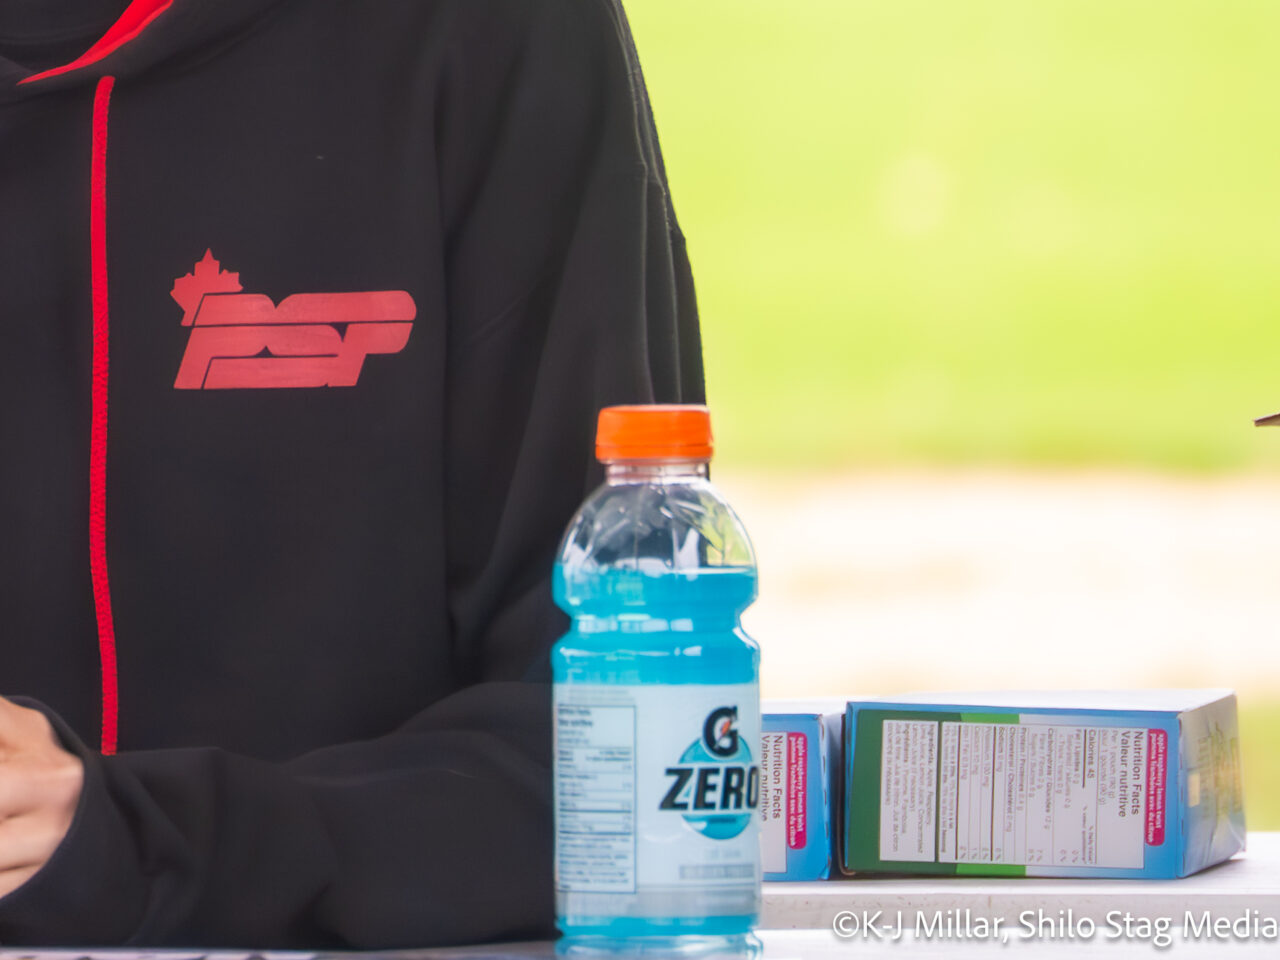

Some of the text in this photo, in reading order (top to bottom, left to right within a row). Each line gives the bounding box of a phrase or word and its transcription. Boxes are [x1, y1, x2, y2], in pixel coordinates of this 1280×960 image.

[703, 706, 738, 757] G
[1088, 729, 1096, 766] Calories
[1132, 731, 1143, 815] Nutrition Facts
[659, 766, 759, 811] ZERO
[760, 736, 769, 821] Valeur nutritive
[773, 735, 783, 819] Nutrition Facts
[1119, 731, 1131, 818] Valeur nutritive
